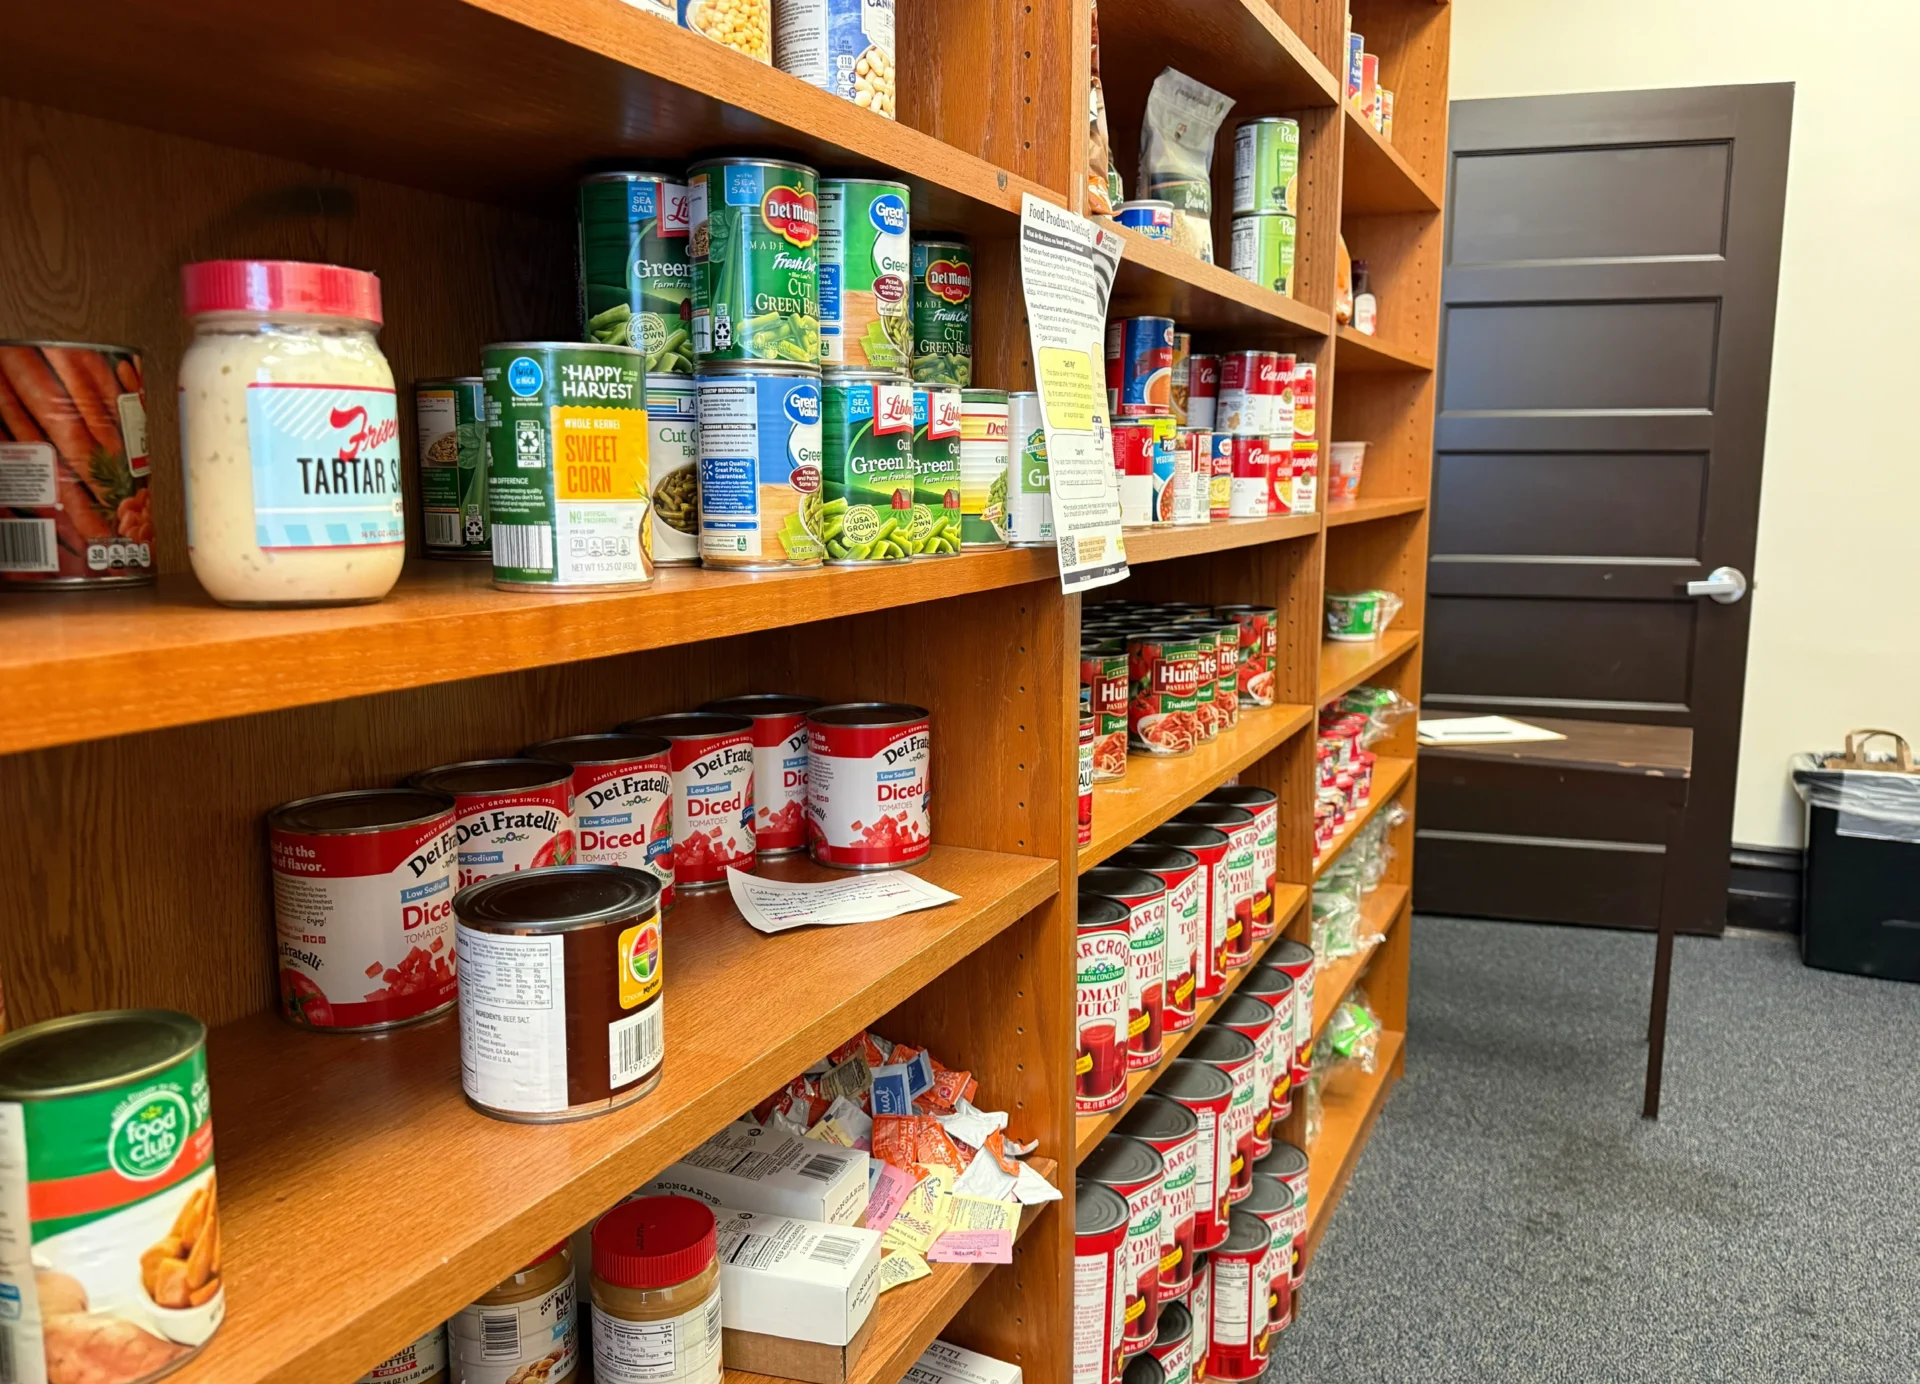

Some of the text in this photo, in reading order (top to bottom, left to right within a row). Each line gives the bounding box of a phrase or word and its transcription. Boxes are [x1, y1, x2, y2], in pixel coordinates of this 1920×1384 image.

[840, 57, 852, 66] 110
[633, 197, 651, 205] SEA
[632, 205, 653, 213] SALT
[769, 201, 791, 220] Del
[876, 202, 904, 219] Great
[885, 216, 904, 228] Value
[1029, 204, 1070, 230] Food Product
[788, 222, 810, 236] Quality
[1133, 226, 1160, 235] VIENNA
[750, 241, 784, 250] MADE
[772, 252, 802, 270] Fresh
[653, 279, 674, 289] Farm
[932, 272, 971, 287] Del Monte
[788, 279, 812, 298] CUT
[946, 288, 962, 296] Quality
[755, 293, 801, 313] GREEN
[637, 324, 655, 333] USA
[945, 328, 963, 341] CUT
[630, 333, 665, 342] GROWN
[920, 340, 954, 353] GREEN
[515, 367, 534, 376] Twice
[568, 365, 622, 382] HAPPY
[562, 381, 633, 399] HARVEST
[790, 394, 817, 410] Great
[799, 406, 819, 418] Value
[565, 418, 621, 430] WHOLE KERNEL
[659, 427, 686, 442] Cut
[565, 434, 617, 463] SWEET
[897, 439, 910, 450] Cut
[851, 457, 904, 475] Green
[914, 459, 954, 475] Green
[297, 458, 386, 494] TARTAR
[497, 477, 528, 485] DIFFERENCE
[567, 466, 611, 493] CORN
[869, 472, 905, 483] Farm Fresh
[924, 476, 940, 484] Farm
[850, 530, 877, 542] NON GMO
[919, 529, 930, 538] GMO
[572, 563, 595, 572] NET WT
[889, 733, 907, 742] FAMILY
[699, 739, 739, 754] FAMILY GROWN
[883, 743, 908, 766] Dei
[593, 765, 643, 782] FAMILY GROWN
[693, 757, 723, 780] Dei
[894, 770, 915, 779] Sodium
[585, 775, 670, 810] Dei Fratelli
[690, 783, 730, 795] Low Sodium
[877, 783, 923, 802] Diced
[459, 803, 484, 815] FAMILY
[687, 791, 741, 817] Diced
[878, 801, 913, 812] TOMATOES
[456, 811, 560, 845] Dei Fratelli
[601, 816, 629, 825] Sodium
[688, 817, 728, 828] TOMATOES
[415, 828, 437, 845] FAMILY
[580, 824, 645, 850] Diced
[295, 846, 316, 858] the
[467, 854, 499, 862] Sodium
[581, 852, 627, 862] TOMATOES
[288, 858, 326, 872] flavor.
[407, 841, 440, 879] Dei
[406, 881, 447, 900] Low Sodium
[307, 916, 327, 927] Enjoy!
[404, 922, 448, 944] TOMATOES
[284, 942, 321, 971] Fratelli
[476, 1009, 501, 1021] INGREDIENTS:
[1077, 999, 1120, 1018] JUICE
[127, 1106, 176, 1144] food
[907, 1121, 915, 1137] HOT
[130, 1132, 176, 1162] club
[930, 1127, 952, 1163] HOT TACO
[777, 1143, 803, 1165] REFRIGERATED
[657, 1182, 721, 1206] BONGARDS
[781, 1224, 806, 1252] REFRIGERATED
[555, 1282, 575, 1309] NUT
[614, 1331, 626, 1339] Total
[614, 1355, 631, 1363] Protein
[939, 1354, 968, 1369] PRODUCT
[378, 1363, 412, 1376] CREAMY
[410, 1364, 435, 1381] LB) 454g
